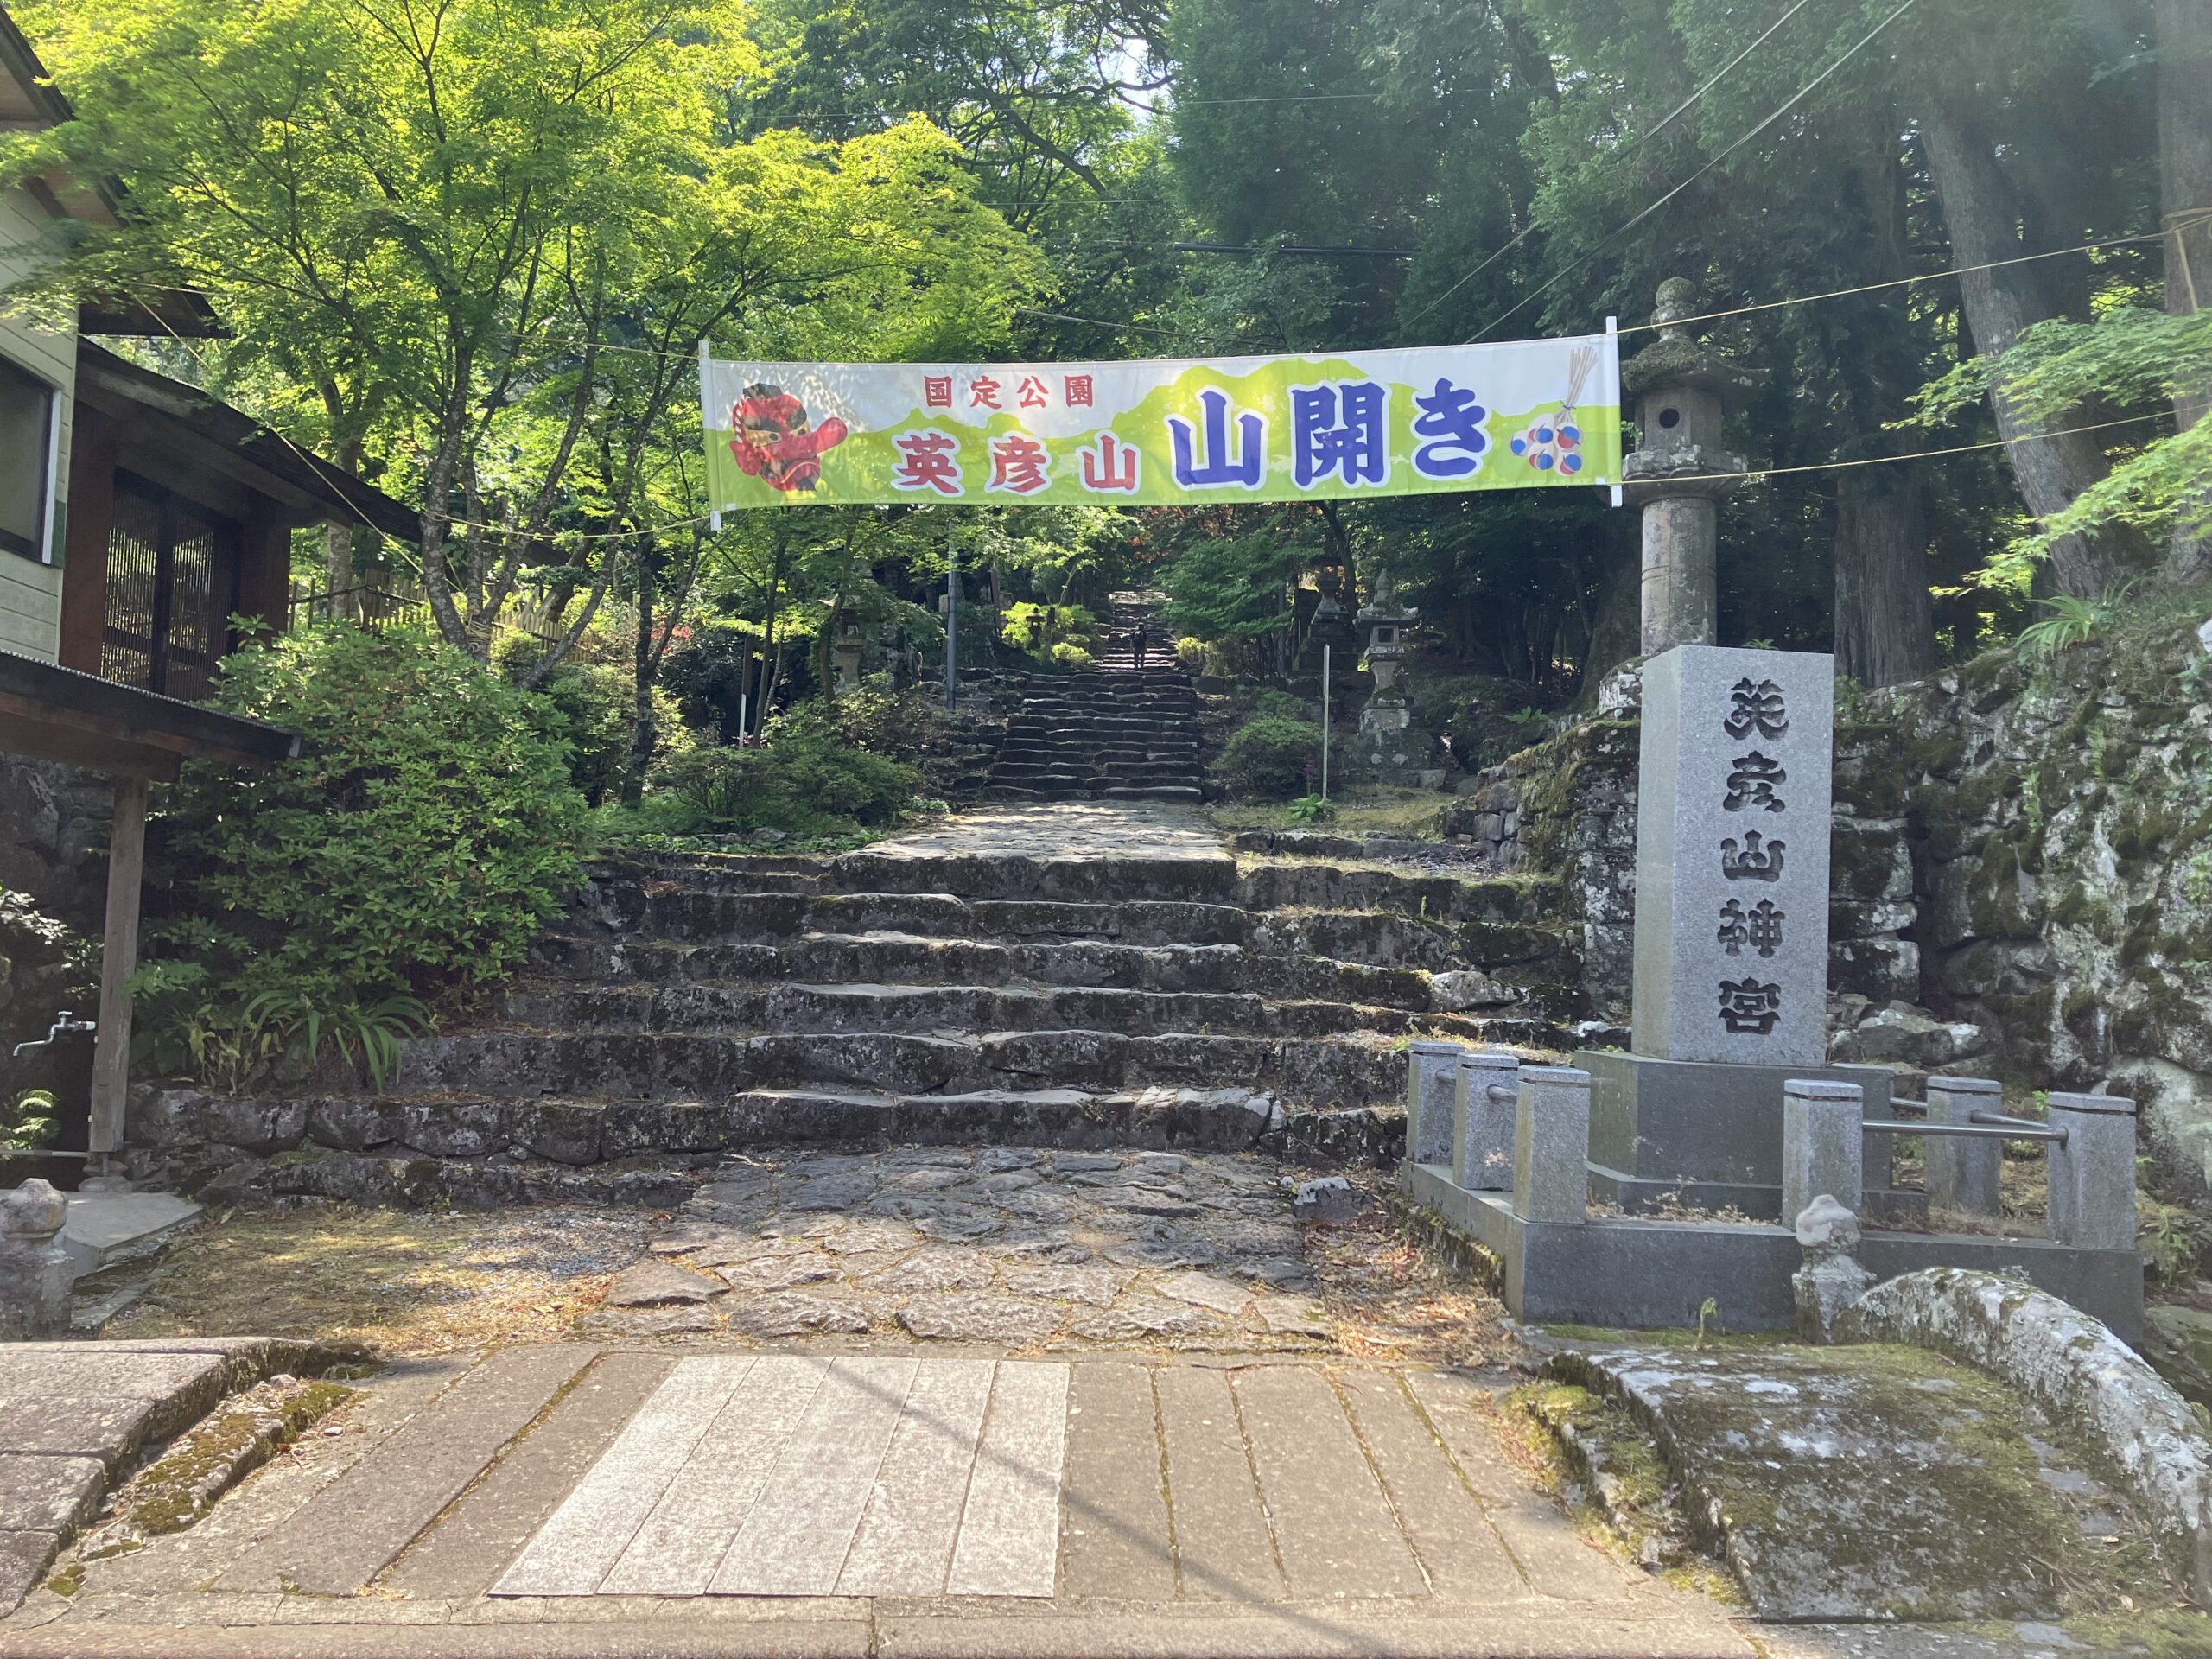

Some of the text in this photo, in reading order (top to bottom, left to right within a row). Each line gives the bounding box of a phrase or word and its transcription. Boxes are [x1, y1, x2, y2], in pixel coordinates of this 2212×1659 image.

[896, 378, 1486, 493] 英彦山 山開き
[924, 375, 1093, 409] 国定公園
[1718, 677, 1789, 1034] 英彦山神宮
